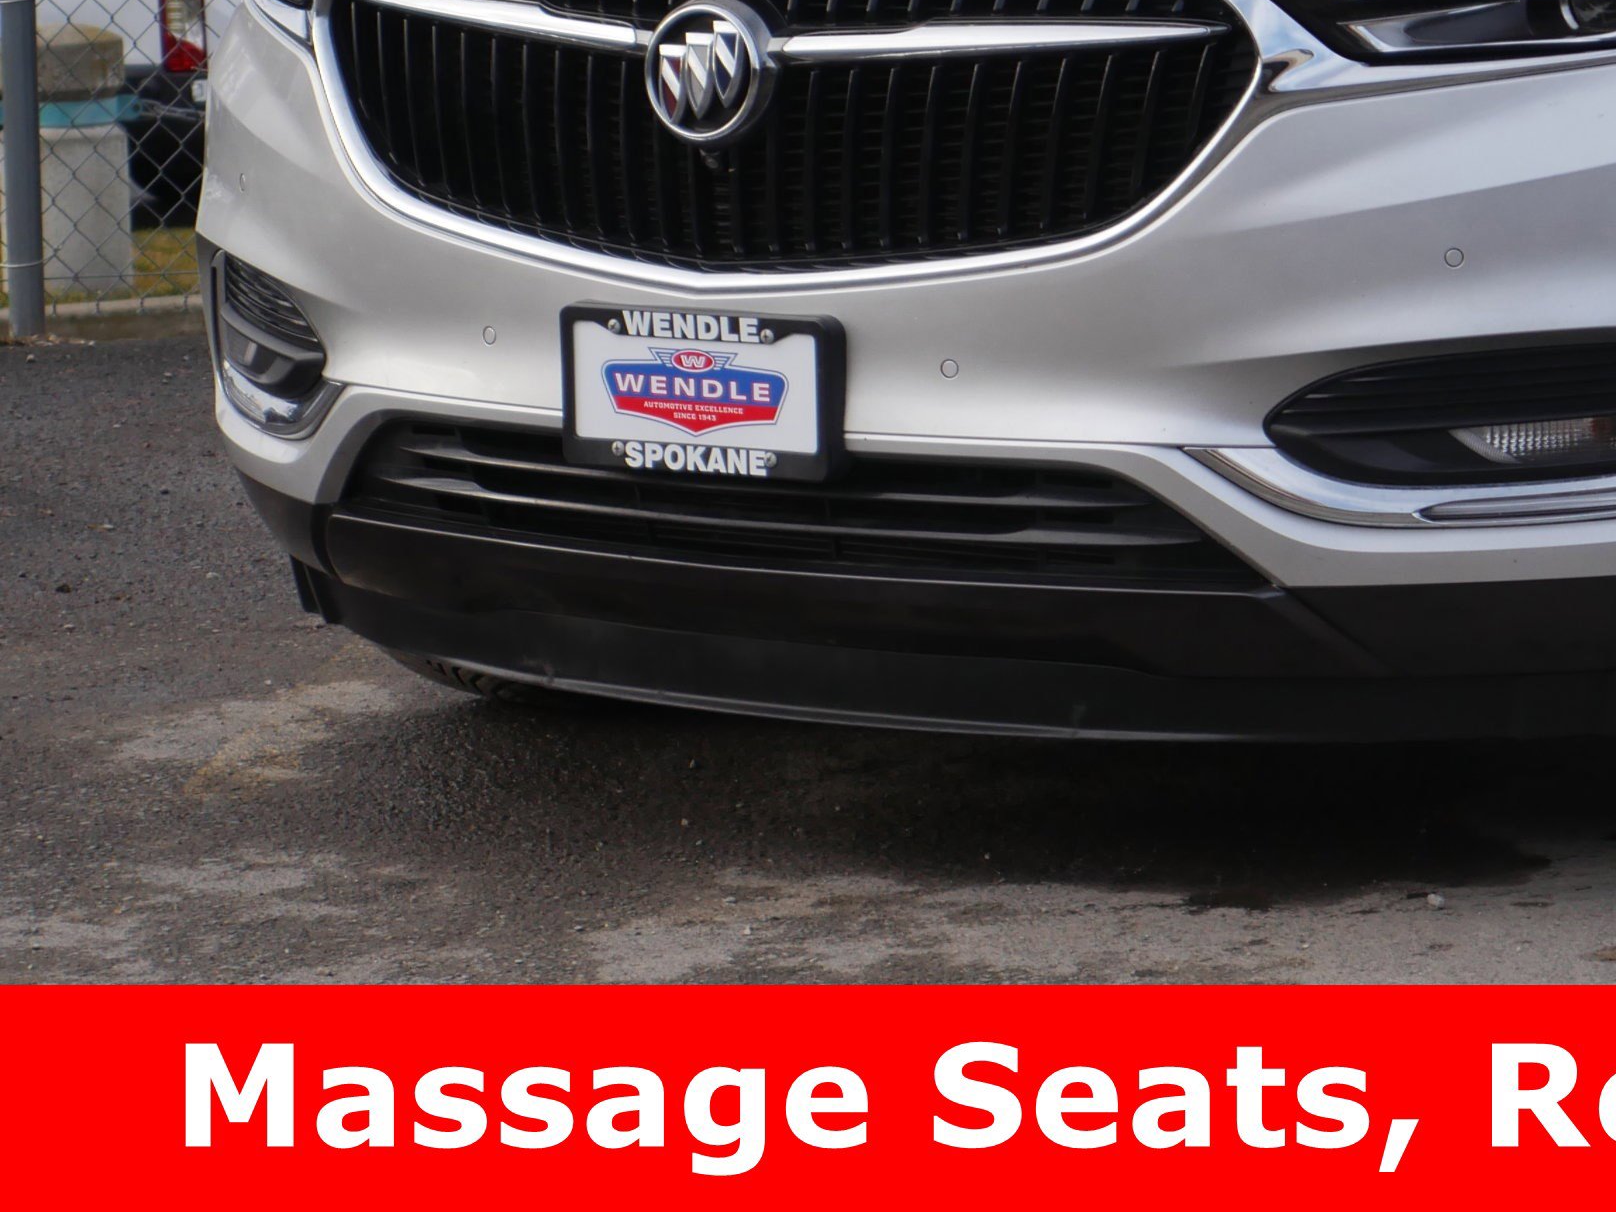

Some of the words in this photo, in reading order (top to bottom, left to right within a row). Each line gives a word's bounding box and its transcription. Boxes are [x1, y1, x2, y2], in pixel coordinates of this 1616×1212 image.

[622, 310, 760, 343] WENDLE
[614, 372, 771, 402] WENDLE
[643, 401, 693, 411] AUTOMOTIVE
[694, 404, 744, 415] EXCELLENCE
[673, 412, 697, 420] SINCE
[698, 414, 717, 422] 1943
[625, 440, 768, 477] SPOKANE
